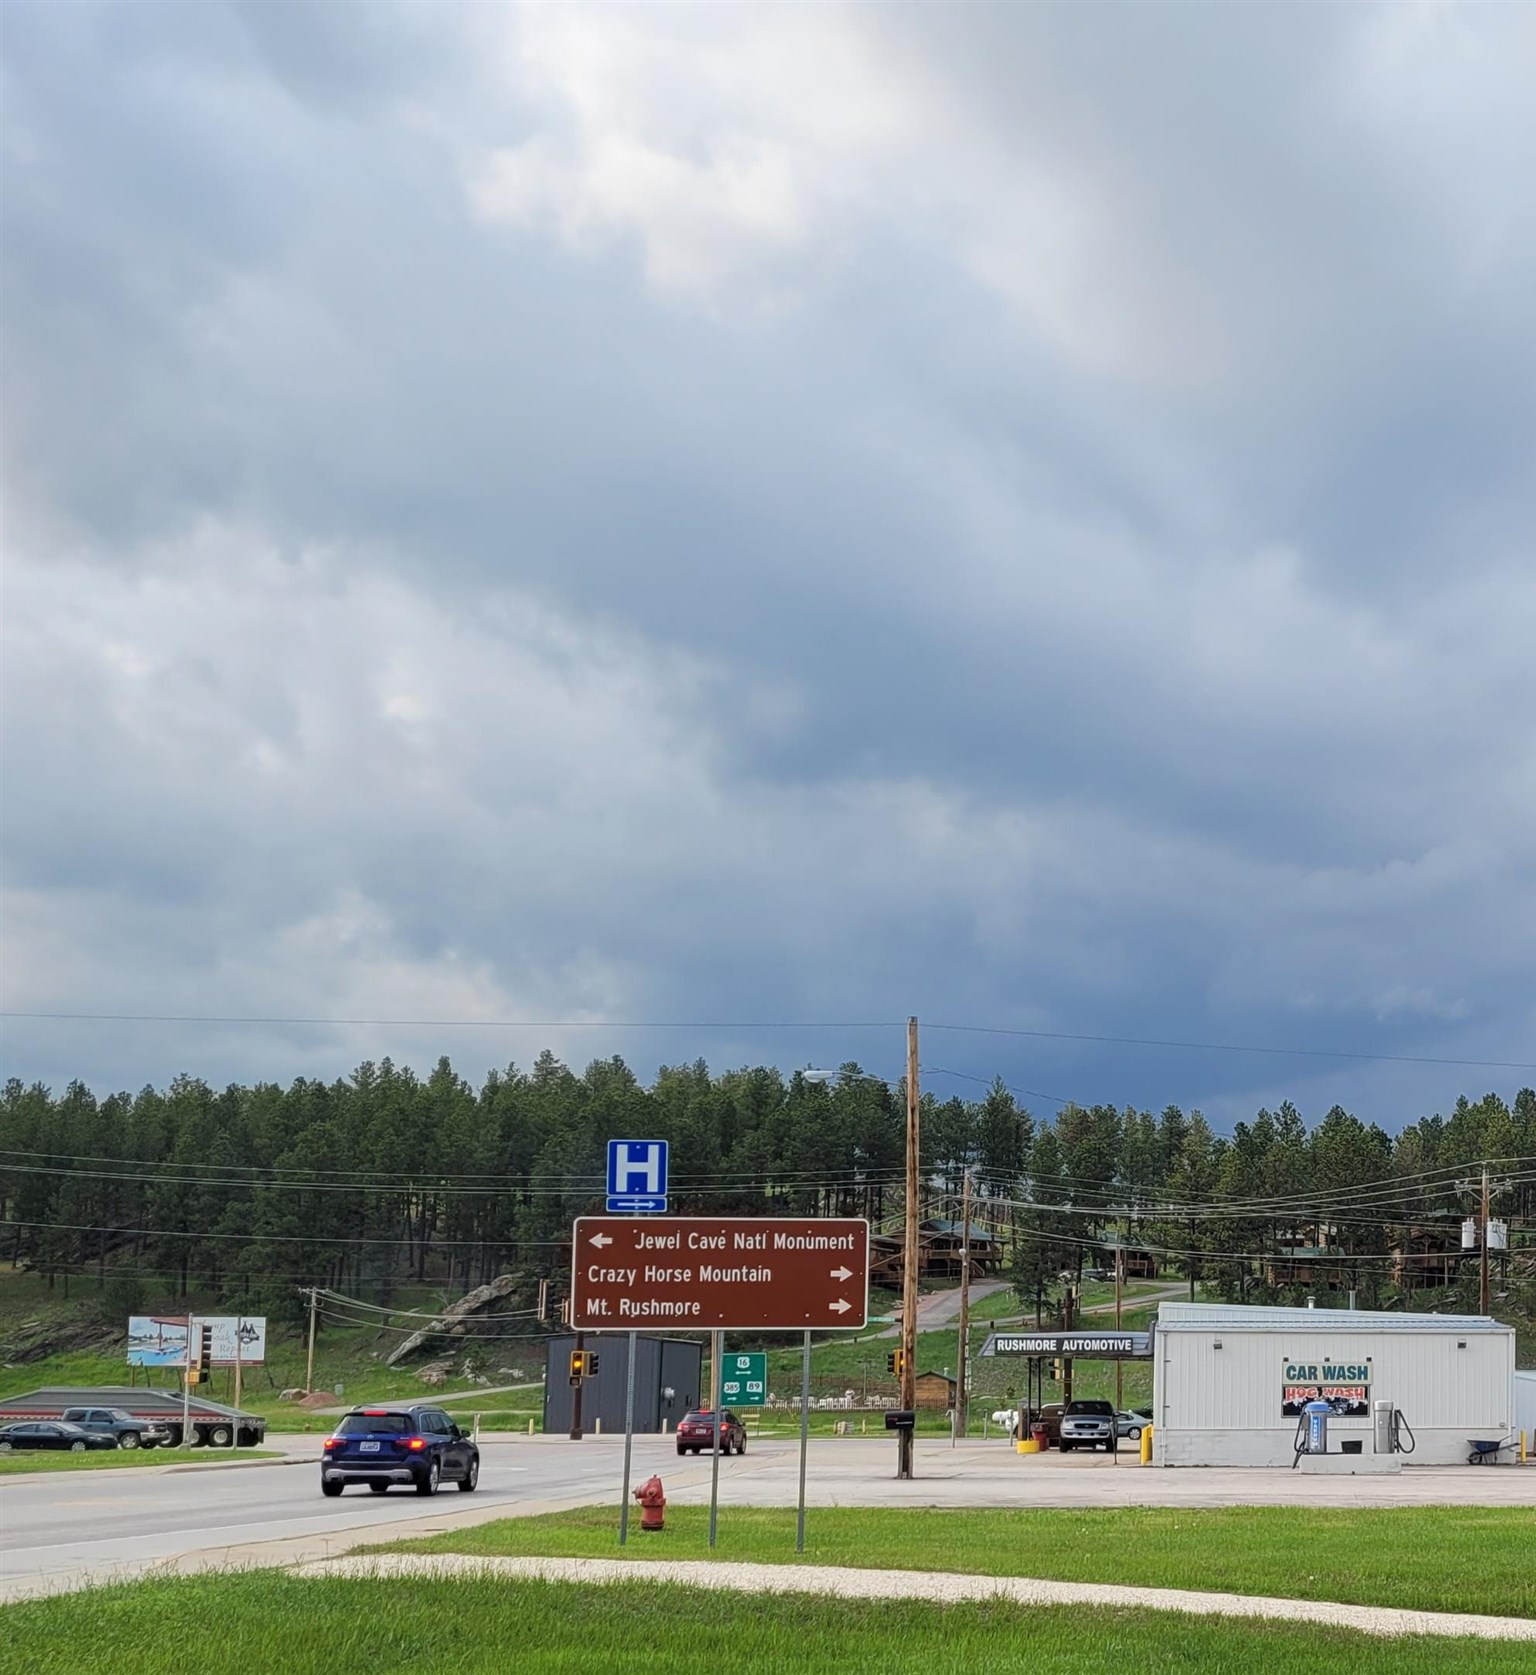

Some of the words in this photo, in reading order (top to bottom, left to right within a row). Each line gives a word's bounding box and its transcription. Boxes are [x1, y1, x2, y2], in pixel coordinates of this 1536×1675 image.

[615, 1144, 660, 1193] H
[634, 1232, 680, 1250] Jewel
[687, 1232, 726, 1250] Cave
[733, 1232, 767, 1250] Natl
[773, 1232, 855, 1250] Monument
[588, 1265, 637, 1287] Crazy
[644, 1265, 692, 1282] Horse
[699, 1265, 772, 1282] Mountain
[586, 1298, 613, 1316] Mt.
[619, 1298, 701, 1316] Rushmore
[997, 1339, 1057, 1351] RUSHMORE
[1062, 1339, 1132, 1351] AUTOMOTIVE
[739, 1358, 749, 1367] 16
[1286, 1365, 1318, 1381] CAR
[1322, 1365, 1369, 1381] WASH
[725, 1383, 739, 1392] 385
[748, 1382, 761, 1391] 89
[1285, 1387, 1318, 1402] HOG
[1321, 1387, 1366, 1401] WASH
